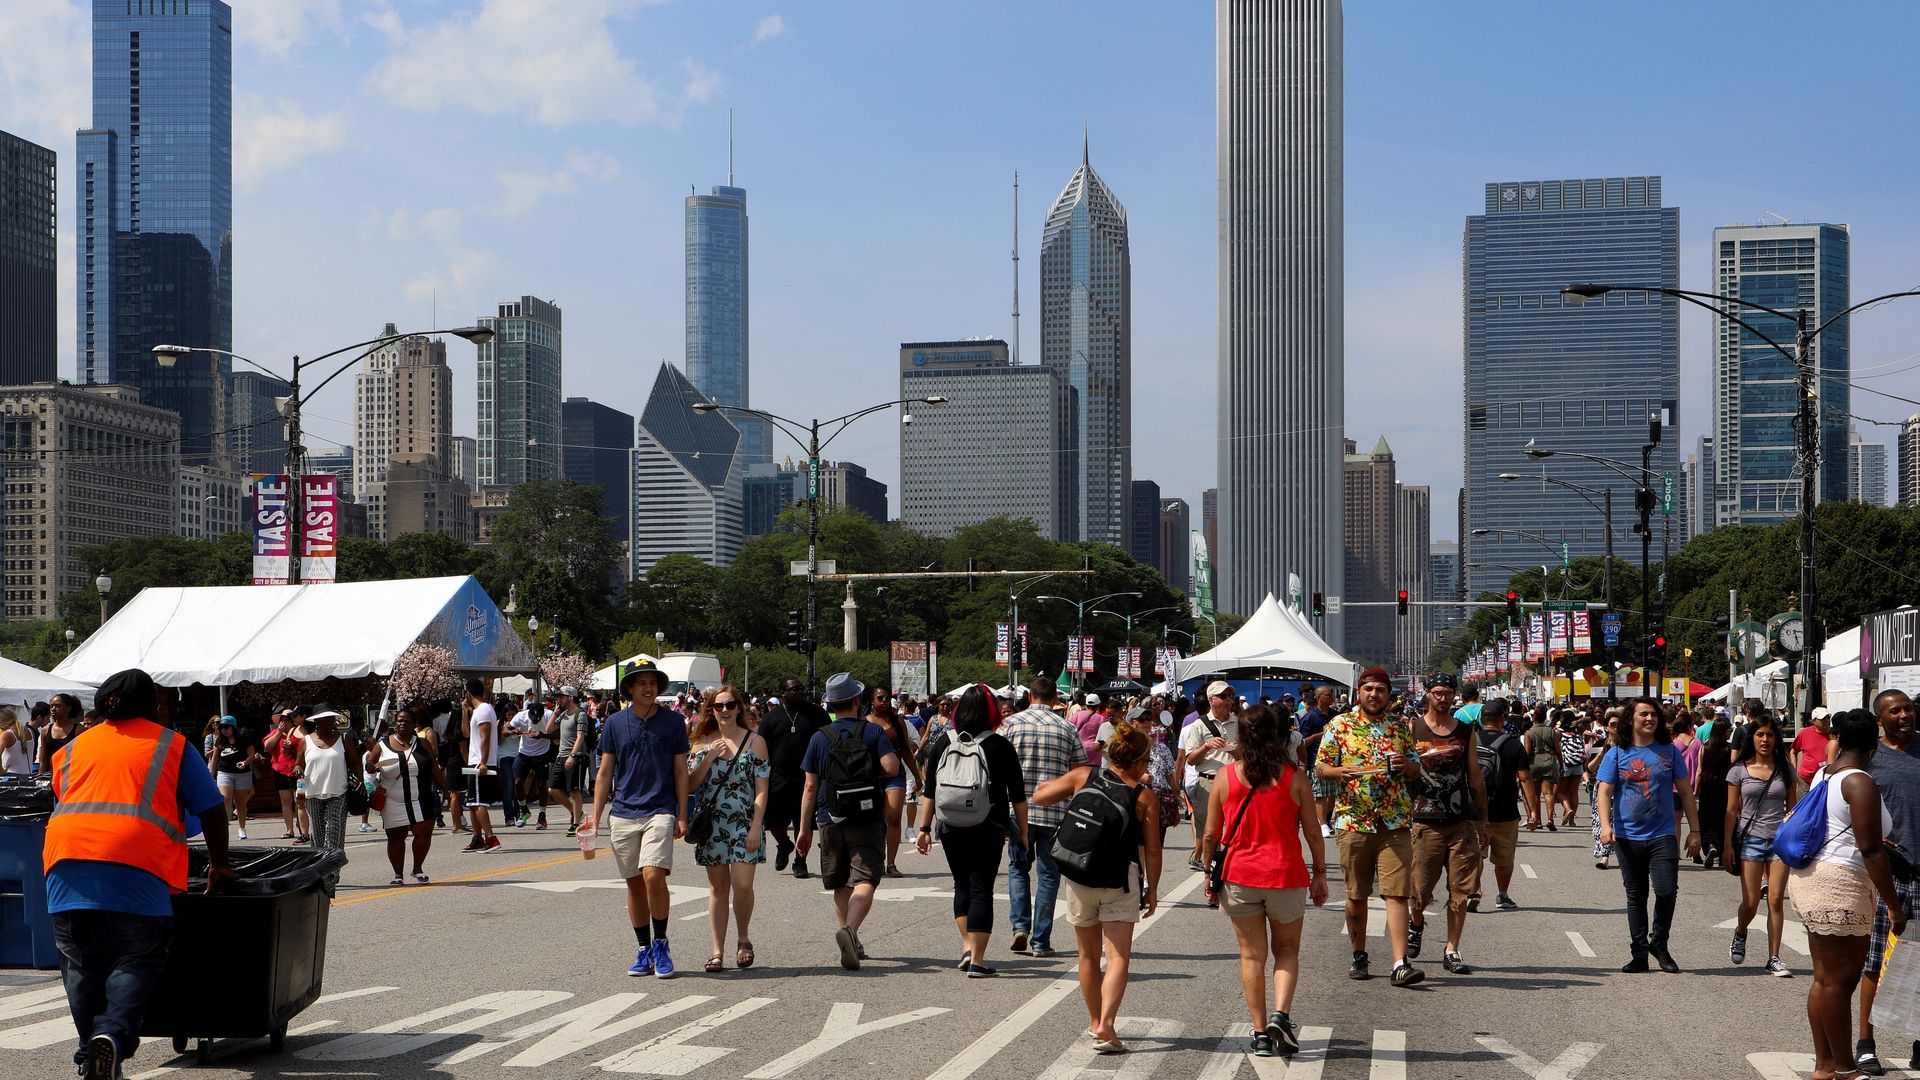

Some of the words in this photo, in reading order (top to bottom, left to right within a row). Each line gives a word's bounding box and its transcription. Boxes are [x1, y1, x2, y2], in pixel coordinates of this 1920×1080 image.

[809, 463, 817, 494] C500
[258, 481, 287, 554] TASTE
[306, 481, 333, 555] TASTE
[1531, 615, 1543, 643] TASTE
[1551, 612, 1565, 638] TAST
[1574, 611, 1588, 637] TAST
[1873, 614, 1892, 664] DOOM
[1892, 610, 1918, 662] STREET
[997, 625, 1008, 652] TASTE
[1069, 637, 1079, 660] TASTE
[1083, 638, 1093, 660] TASTE
[1510, 629, 1521, 652] TASTE
[892, 645, 927, 659] TASTE
[1118, 649, 1127, 668] TASTE
[1131, 648, 1140, 668] TASTE
[1498, 642, 1508, 662] TASTE
[292, 989, 956, 1080] ONLY
